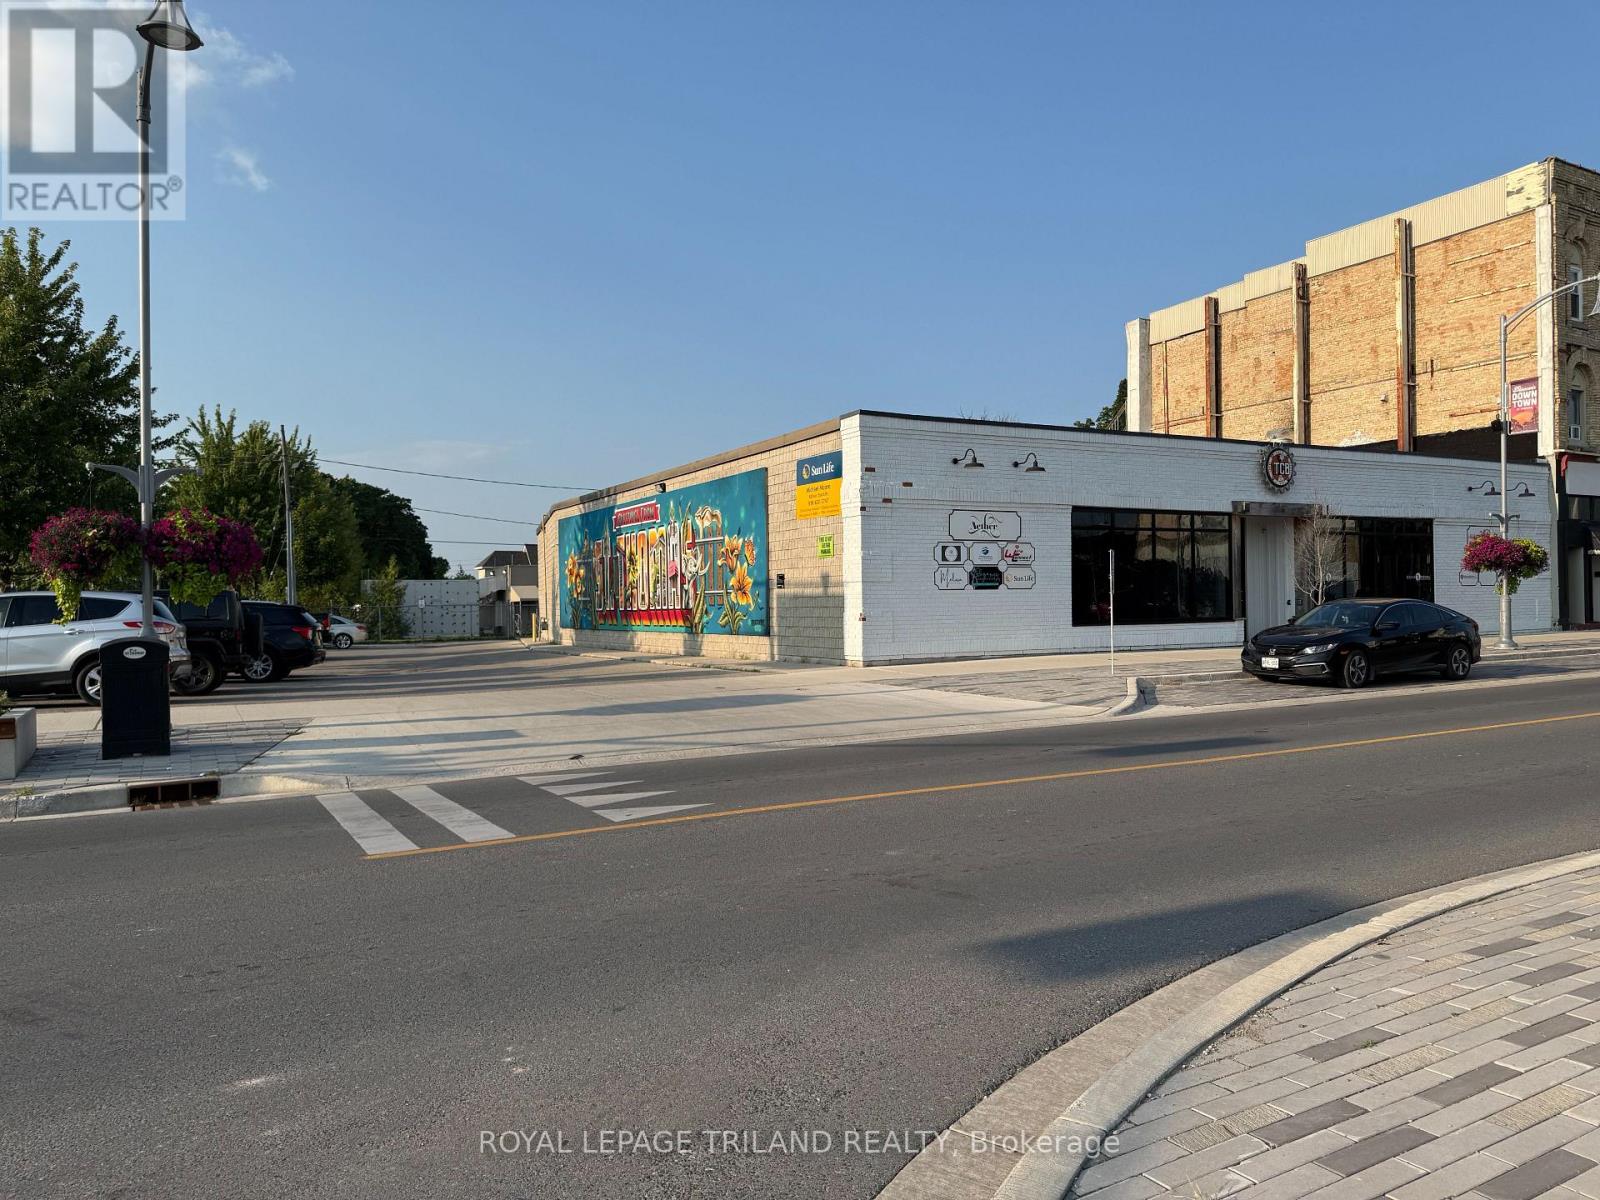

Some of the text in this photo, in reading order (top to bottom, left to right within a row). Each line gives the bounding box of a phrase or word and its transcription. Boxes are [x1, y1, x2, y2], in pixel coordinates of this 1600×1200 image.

[1512, 390, 1537, 401] DOWN
[1512, 398, 1537, 408] TOWN
[811, 461, 835, 476] Sun Life
[1273, 462, 1290, 475] TCB
[1013, 574, 1024, 582] Sun
